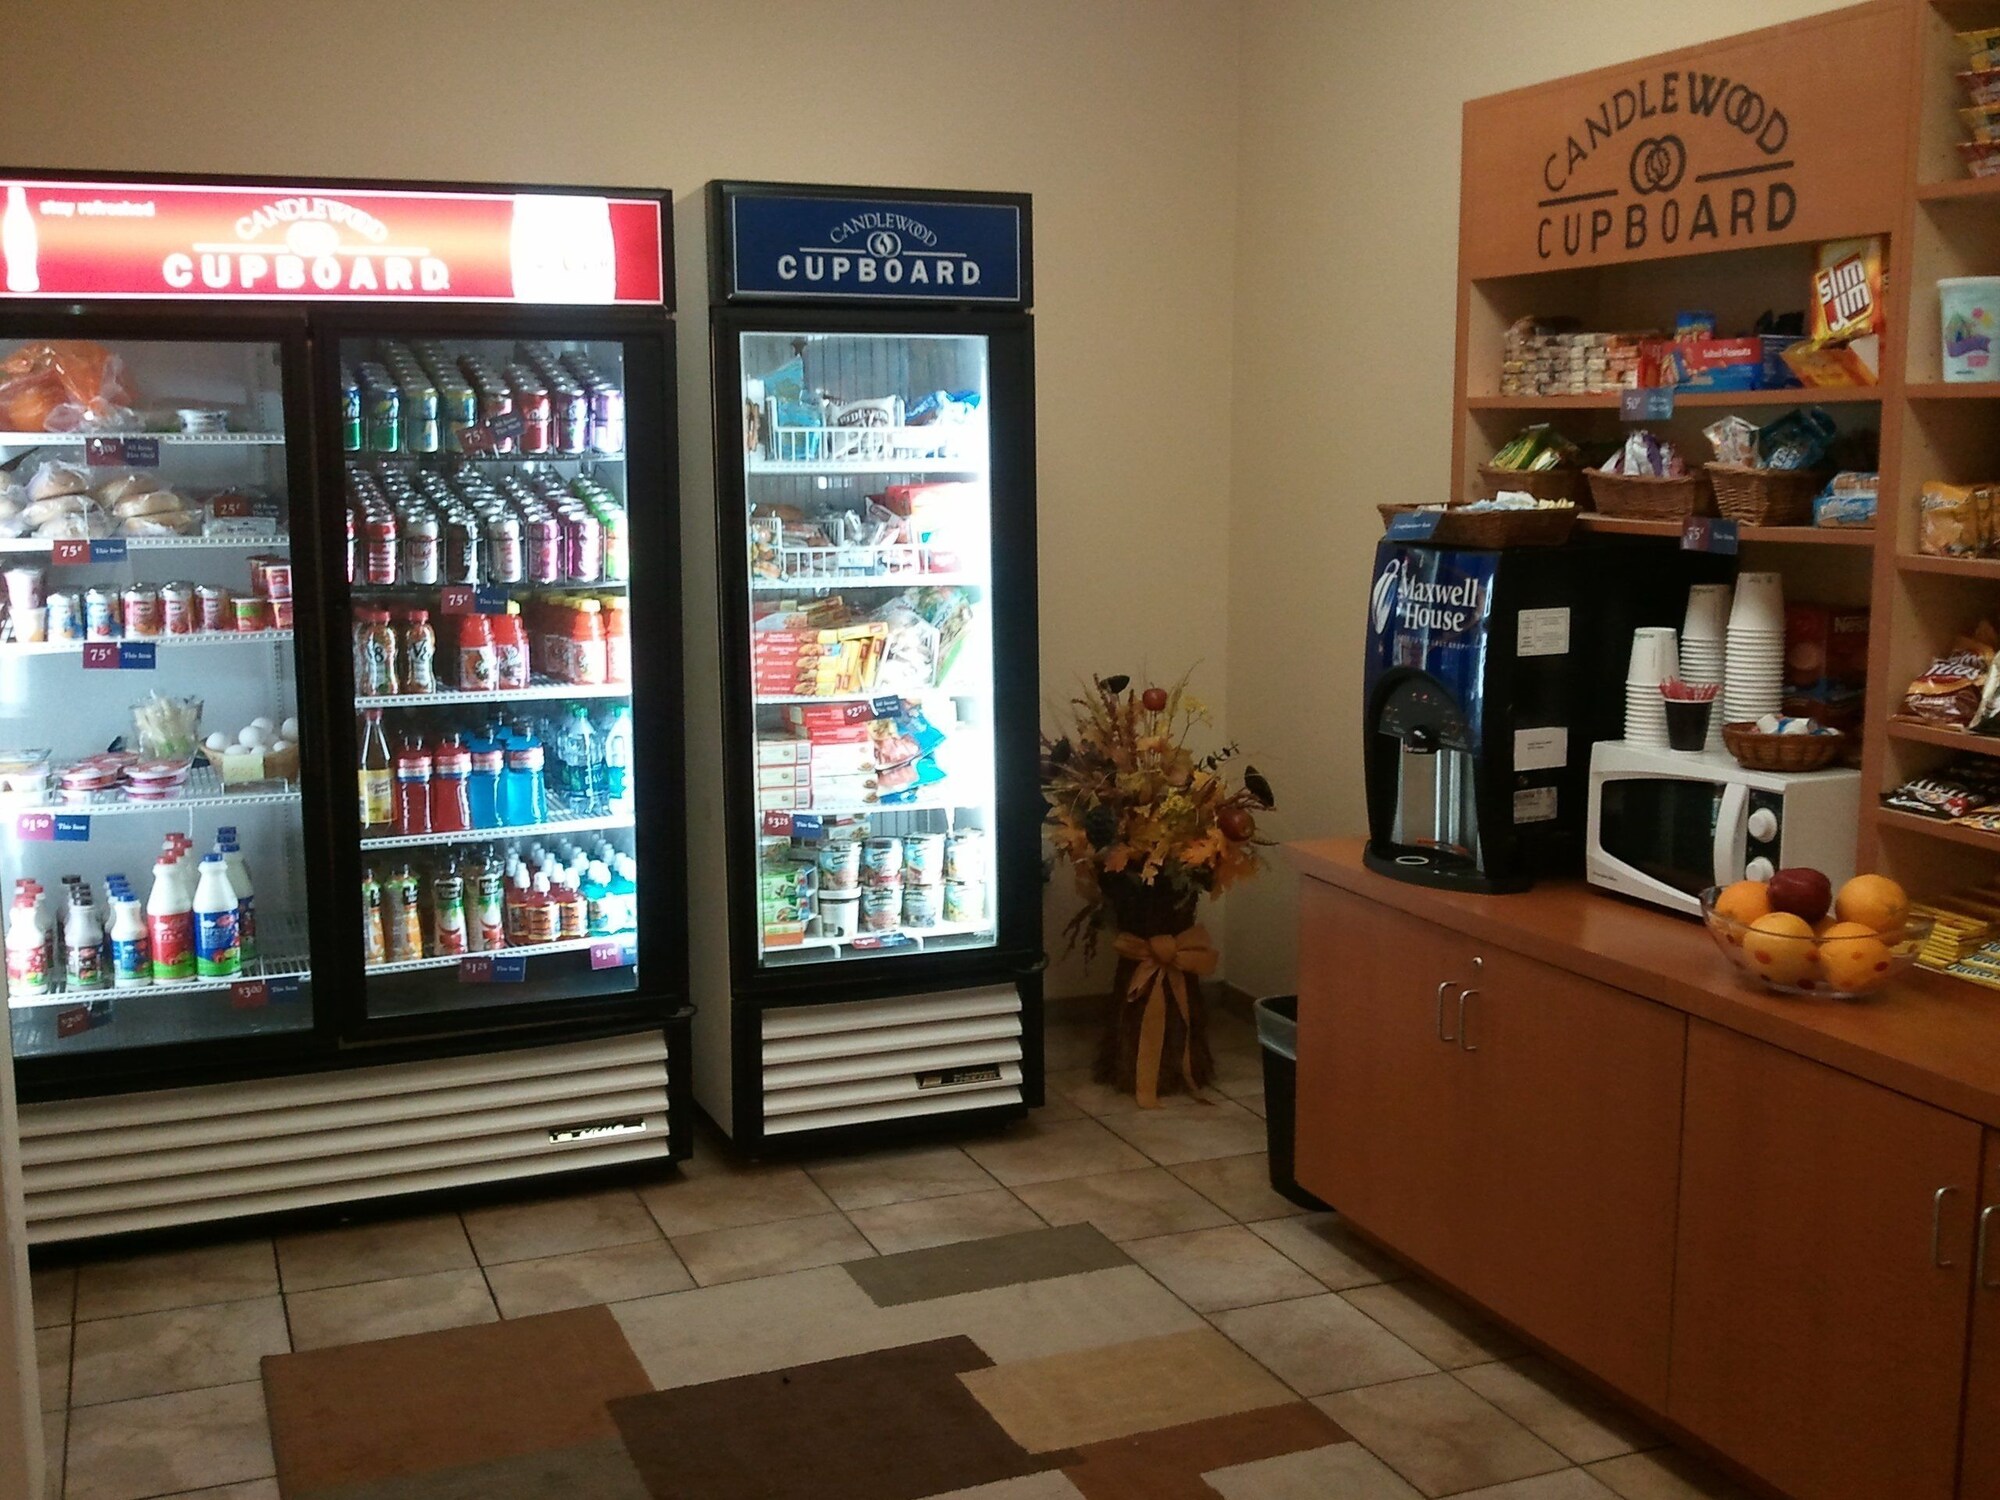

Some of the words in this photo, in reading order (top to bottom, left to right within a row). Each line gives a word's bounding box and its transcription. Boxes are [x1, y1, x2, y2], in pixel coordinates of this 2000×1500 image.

[1544, 71, 1788, 192] CANDLEWOOD
[235, 197, 389, 243] CANDLEWOOD
[830, 212, 938, 247] CANDLEWOOD
[1538, 182, 1797, 258] CUPBOARD
[162, 253, 450, 290] CUPBOARD
[777, 255, 981, 285] CUPBOARD
[60, 545, 83, 558] 75¢
[1401, 567, 1479, 608] Maxwell
[1404, 602, 1466, 633] House
[90, 649, 112, 662] 75¢
